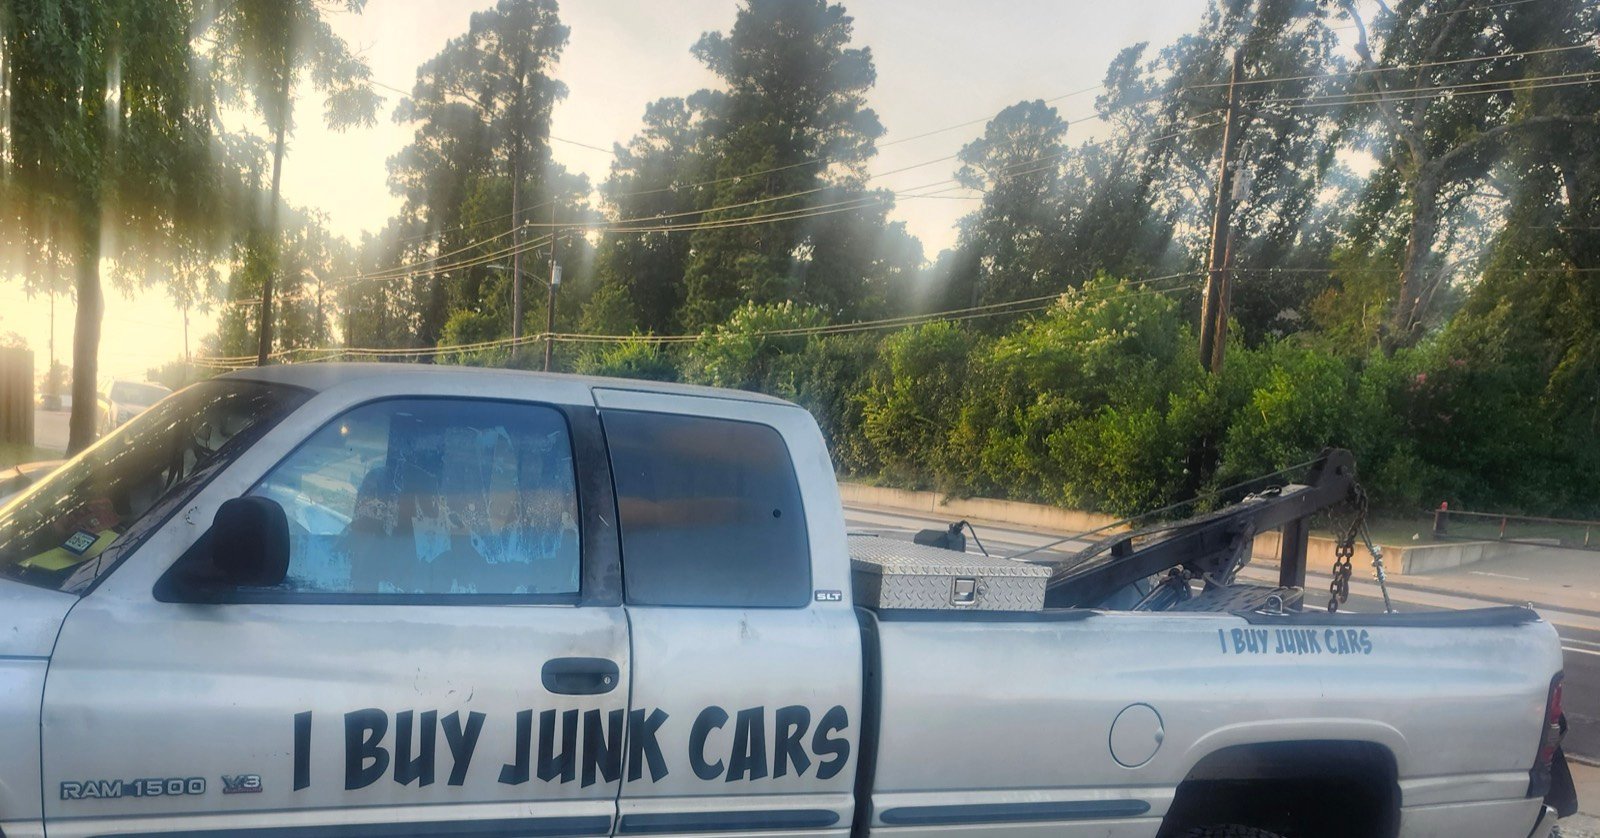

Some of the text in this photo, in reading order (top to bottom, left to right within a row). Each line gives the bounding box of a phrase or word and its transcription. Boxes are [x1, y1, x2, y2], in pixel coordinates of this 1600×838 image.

[816, 592, 842, 601] SLT
[1218, 628, 1373, 656] I BUY JUNK CARS
[293, 704, 851, 792] I BUY JUNK CARS
[62, 777, 206, 799] RAM 1500
